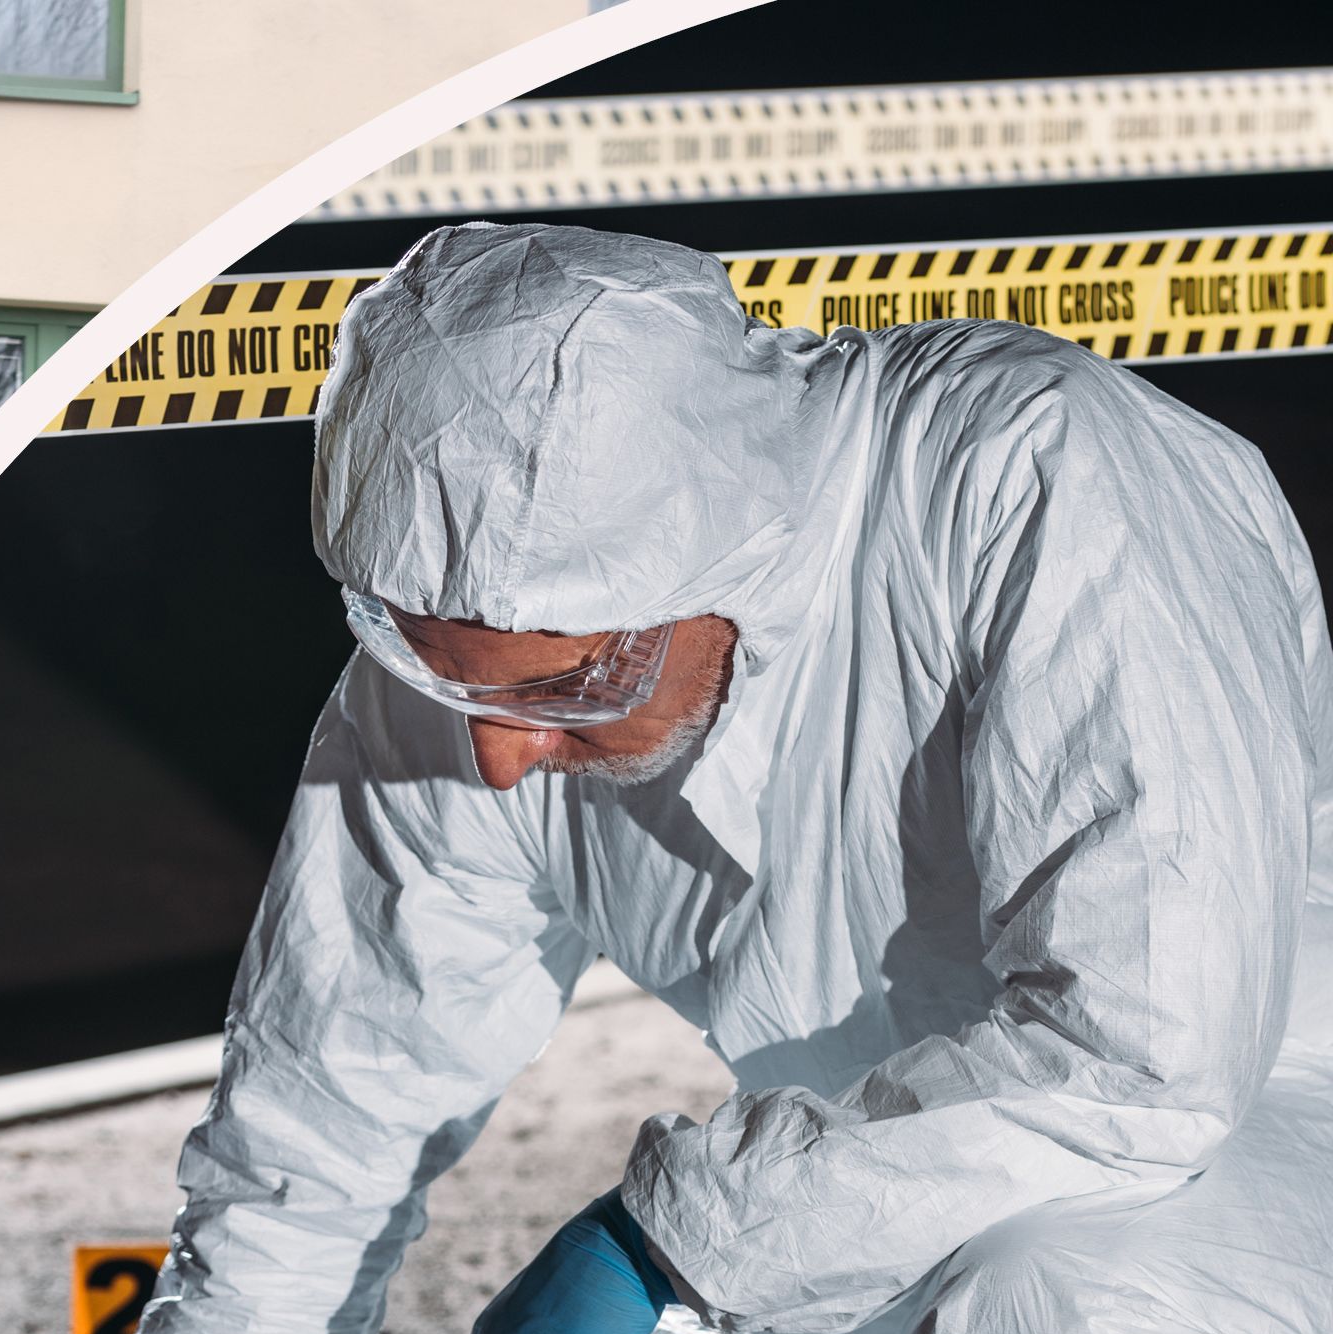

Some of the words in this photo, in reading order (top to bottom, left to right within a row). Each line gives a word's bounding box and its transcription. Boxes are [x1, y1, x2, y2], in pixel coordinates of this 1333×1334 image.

[821, 291, 901, 337] POLICE
[911, 288, 959, 322] LINE
[966, 287, 996, 320] DO
[1007, 284, 1048, 326] NOT
[1058, 281, 1134, 324] CROSS
[1169, 273, 1239, 317] POLICE
[1249, 271, 1289, 312] LINE
[1299, 270, 1326, 309] DO
[177, 328, 216, 379] DO
[228, 326, 282, 375] NOT
